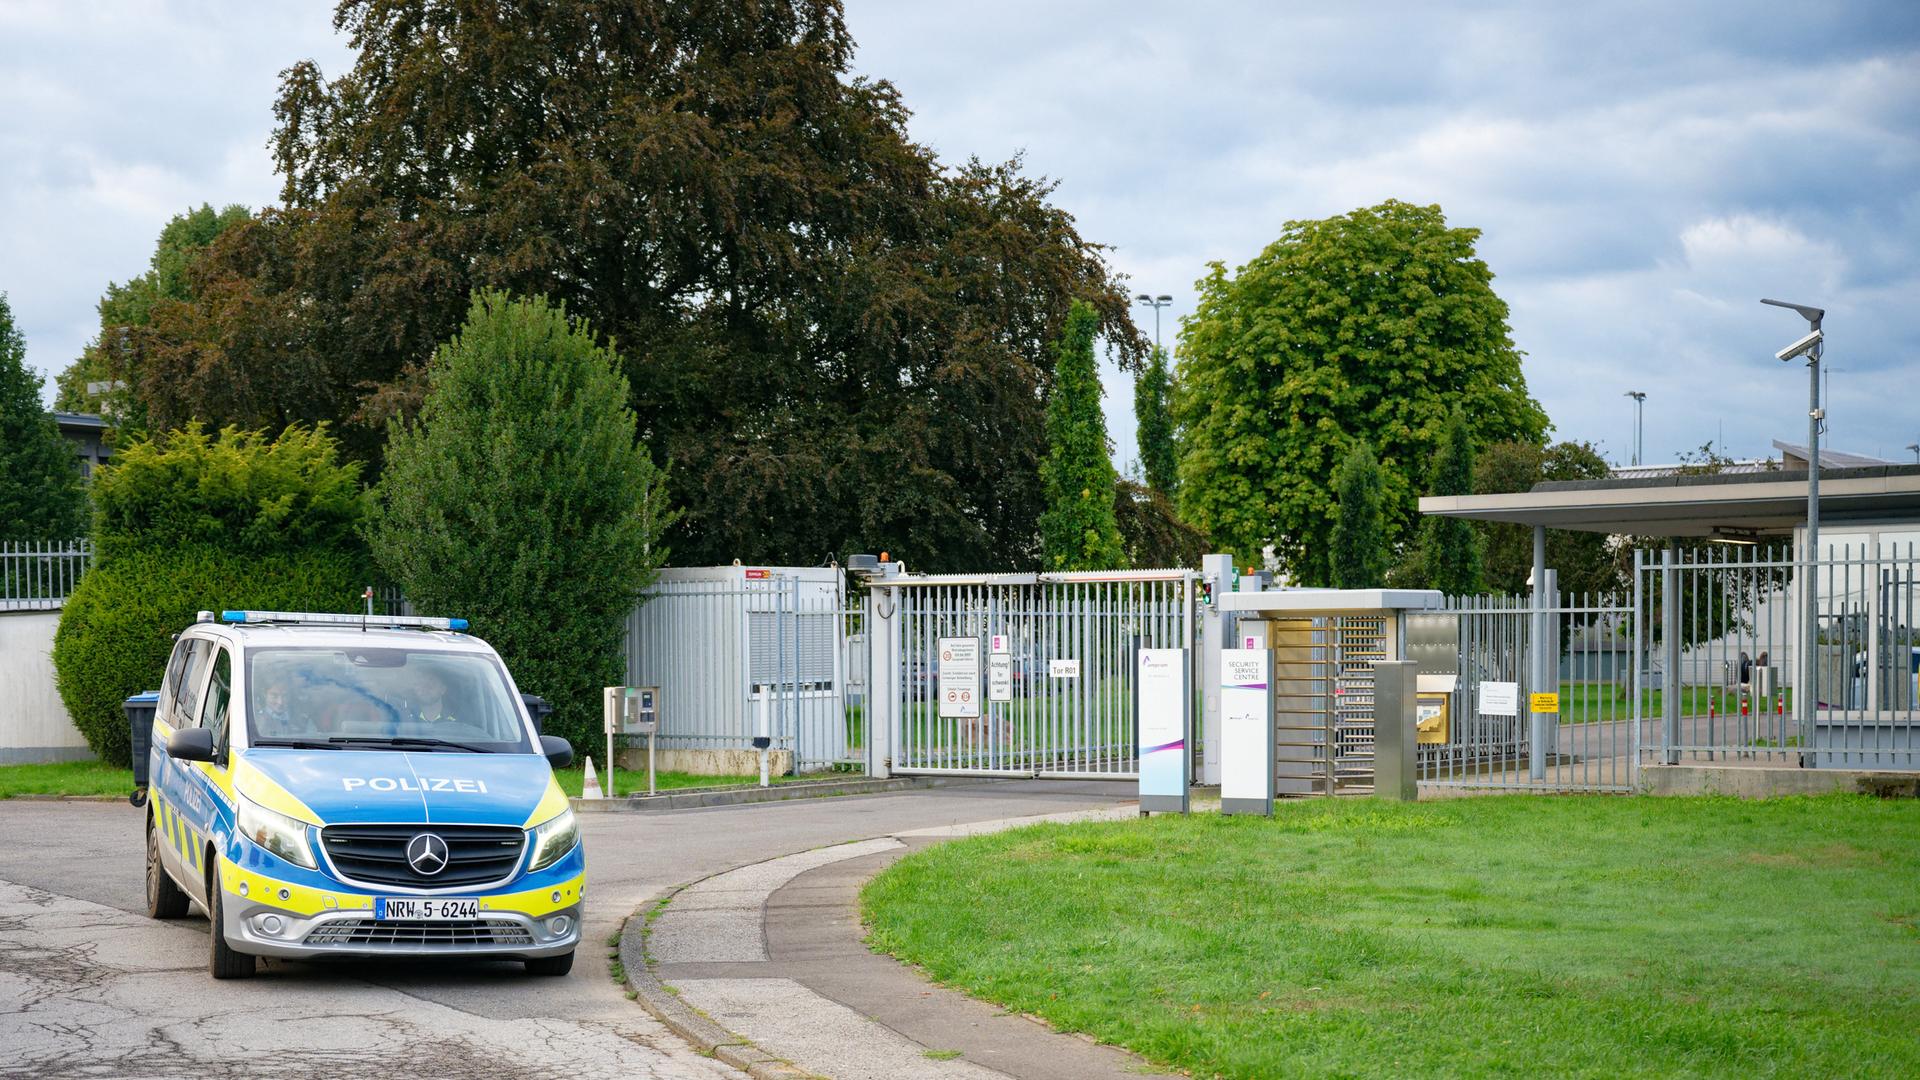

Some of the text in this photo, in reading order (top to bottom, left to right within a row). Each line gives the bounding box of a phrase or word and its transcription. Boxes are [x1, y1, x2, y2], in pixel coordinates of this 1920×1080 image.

[1053, 666, 1076, 674] Tor R01
[342, 777, 488, 793] POLIZEI
[386, 901, 477, 918] NRW 5-6244
